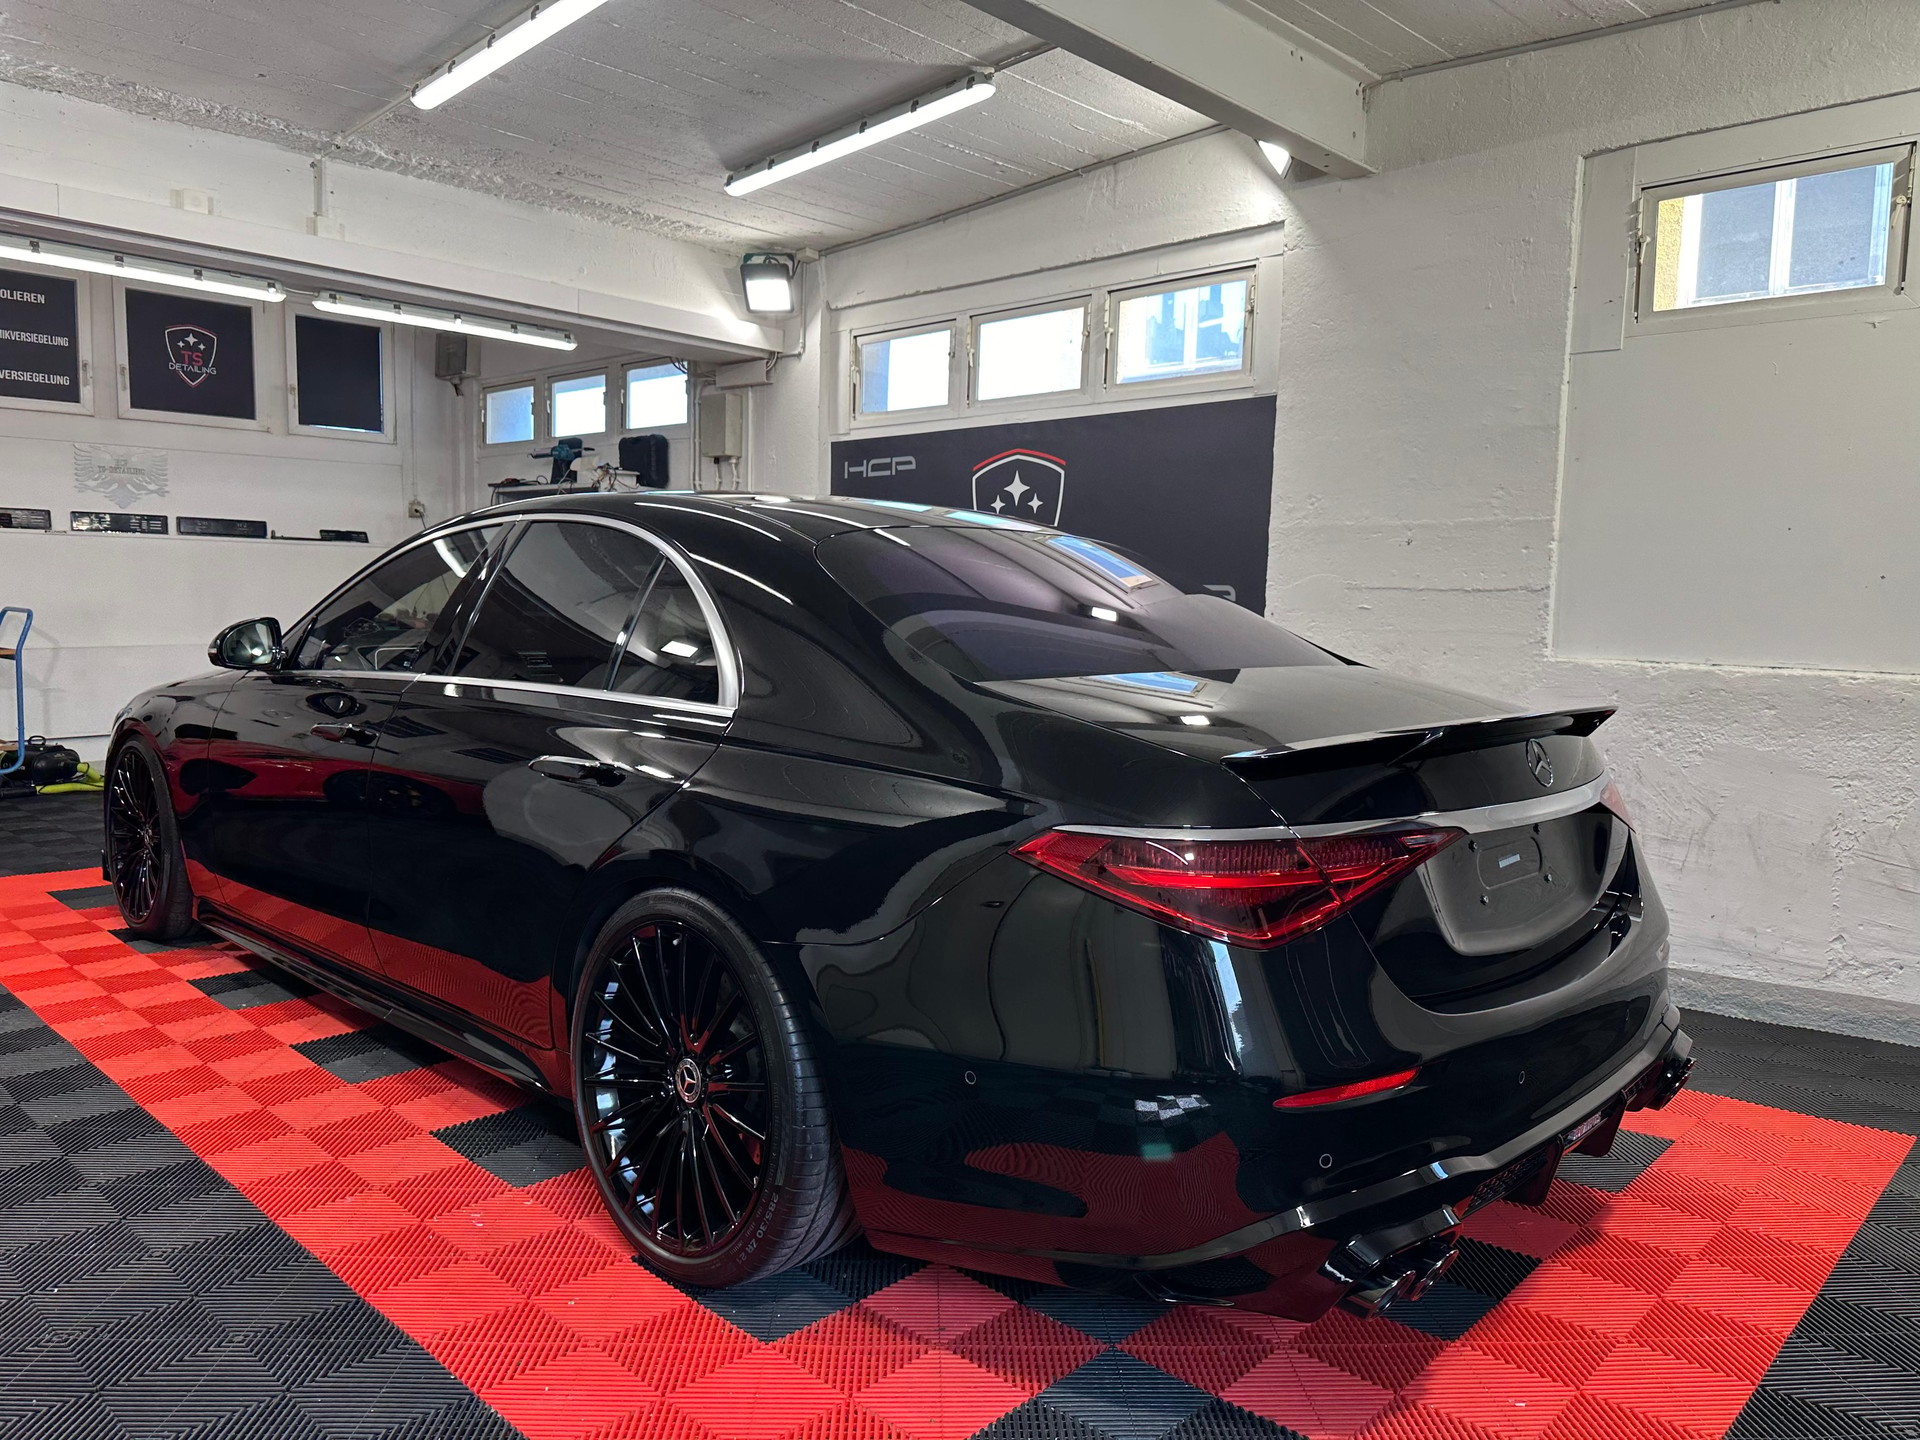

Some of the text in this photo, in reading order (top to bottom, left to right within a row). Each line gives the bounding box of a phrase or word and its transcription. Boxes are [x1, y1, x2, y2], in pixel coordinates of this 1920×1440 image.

[0, 288, 45, 304] OLIEREN
[180, 350, 203, 366] TS
[168, 362, 217, 375] DETAILING
[844, 455, 917, 479] HCP
[756, 1192, 779, 1239] 285/30
